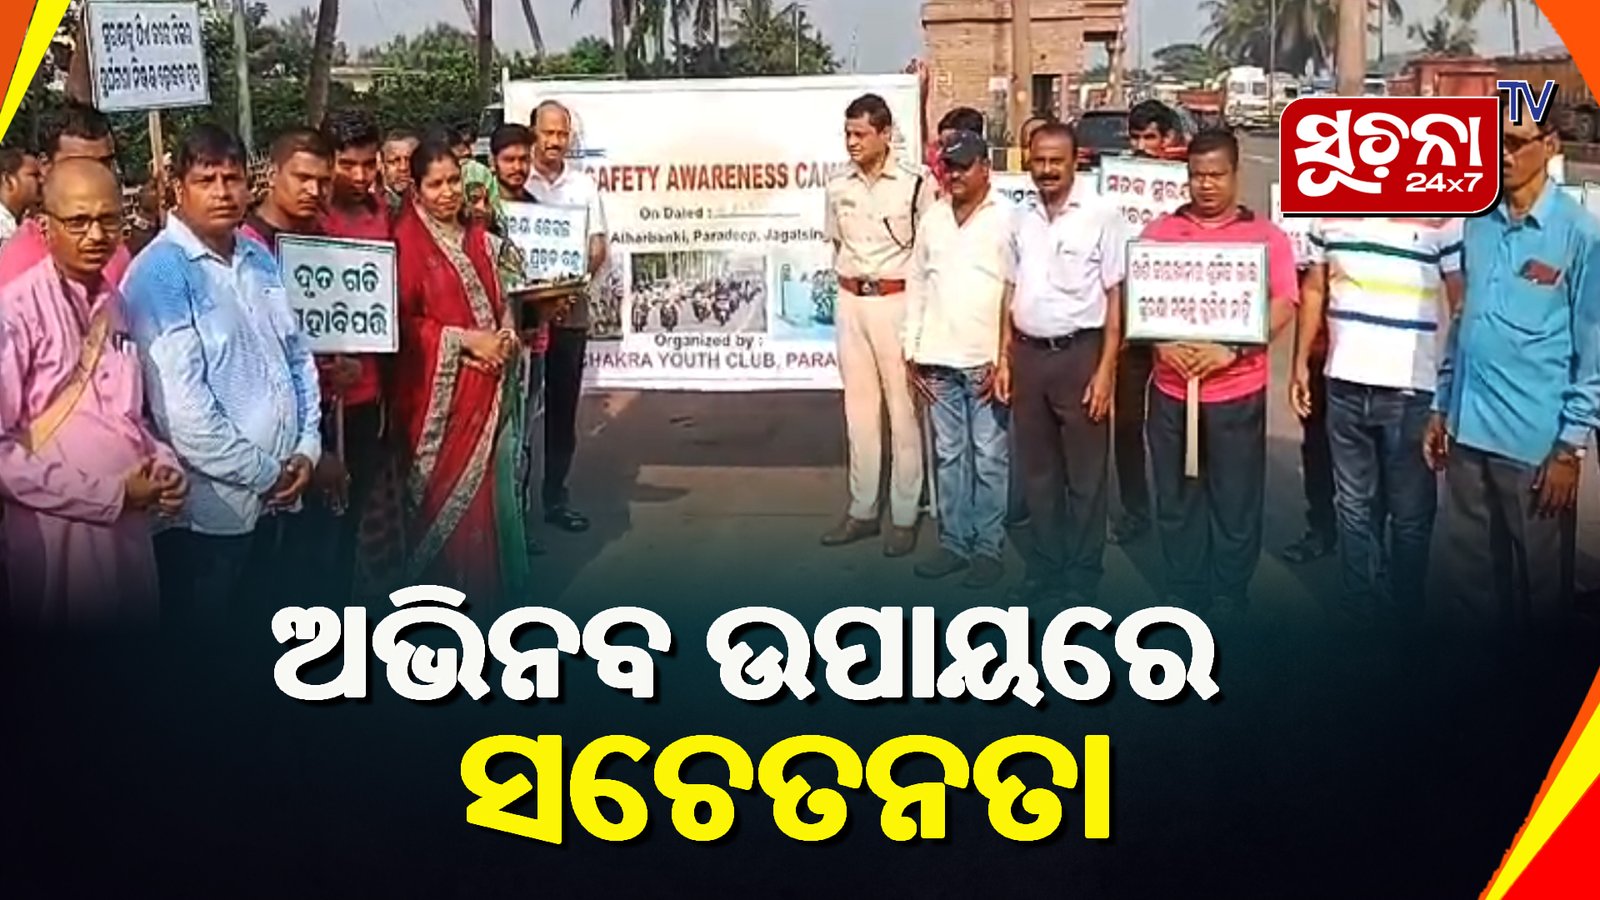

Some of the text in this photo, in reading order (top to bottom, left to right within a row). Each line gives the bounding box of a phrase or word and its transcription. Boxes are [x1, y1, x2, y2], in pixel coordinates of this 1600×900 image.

[666, 162, 789, 191] AWARENESS
[639, 207, 659, 221] On
[693, 228, 761, 244] Paradeep,
[341, 261, 380, 293] ଗତି
[654, 334, 731, 350] Organized
[736, 334, 755, 350] by
[658, 351, 721, 369] YOUTH
[726, 351, 783, 371] CLUB,
